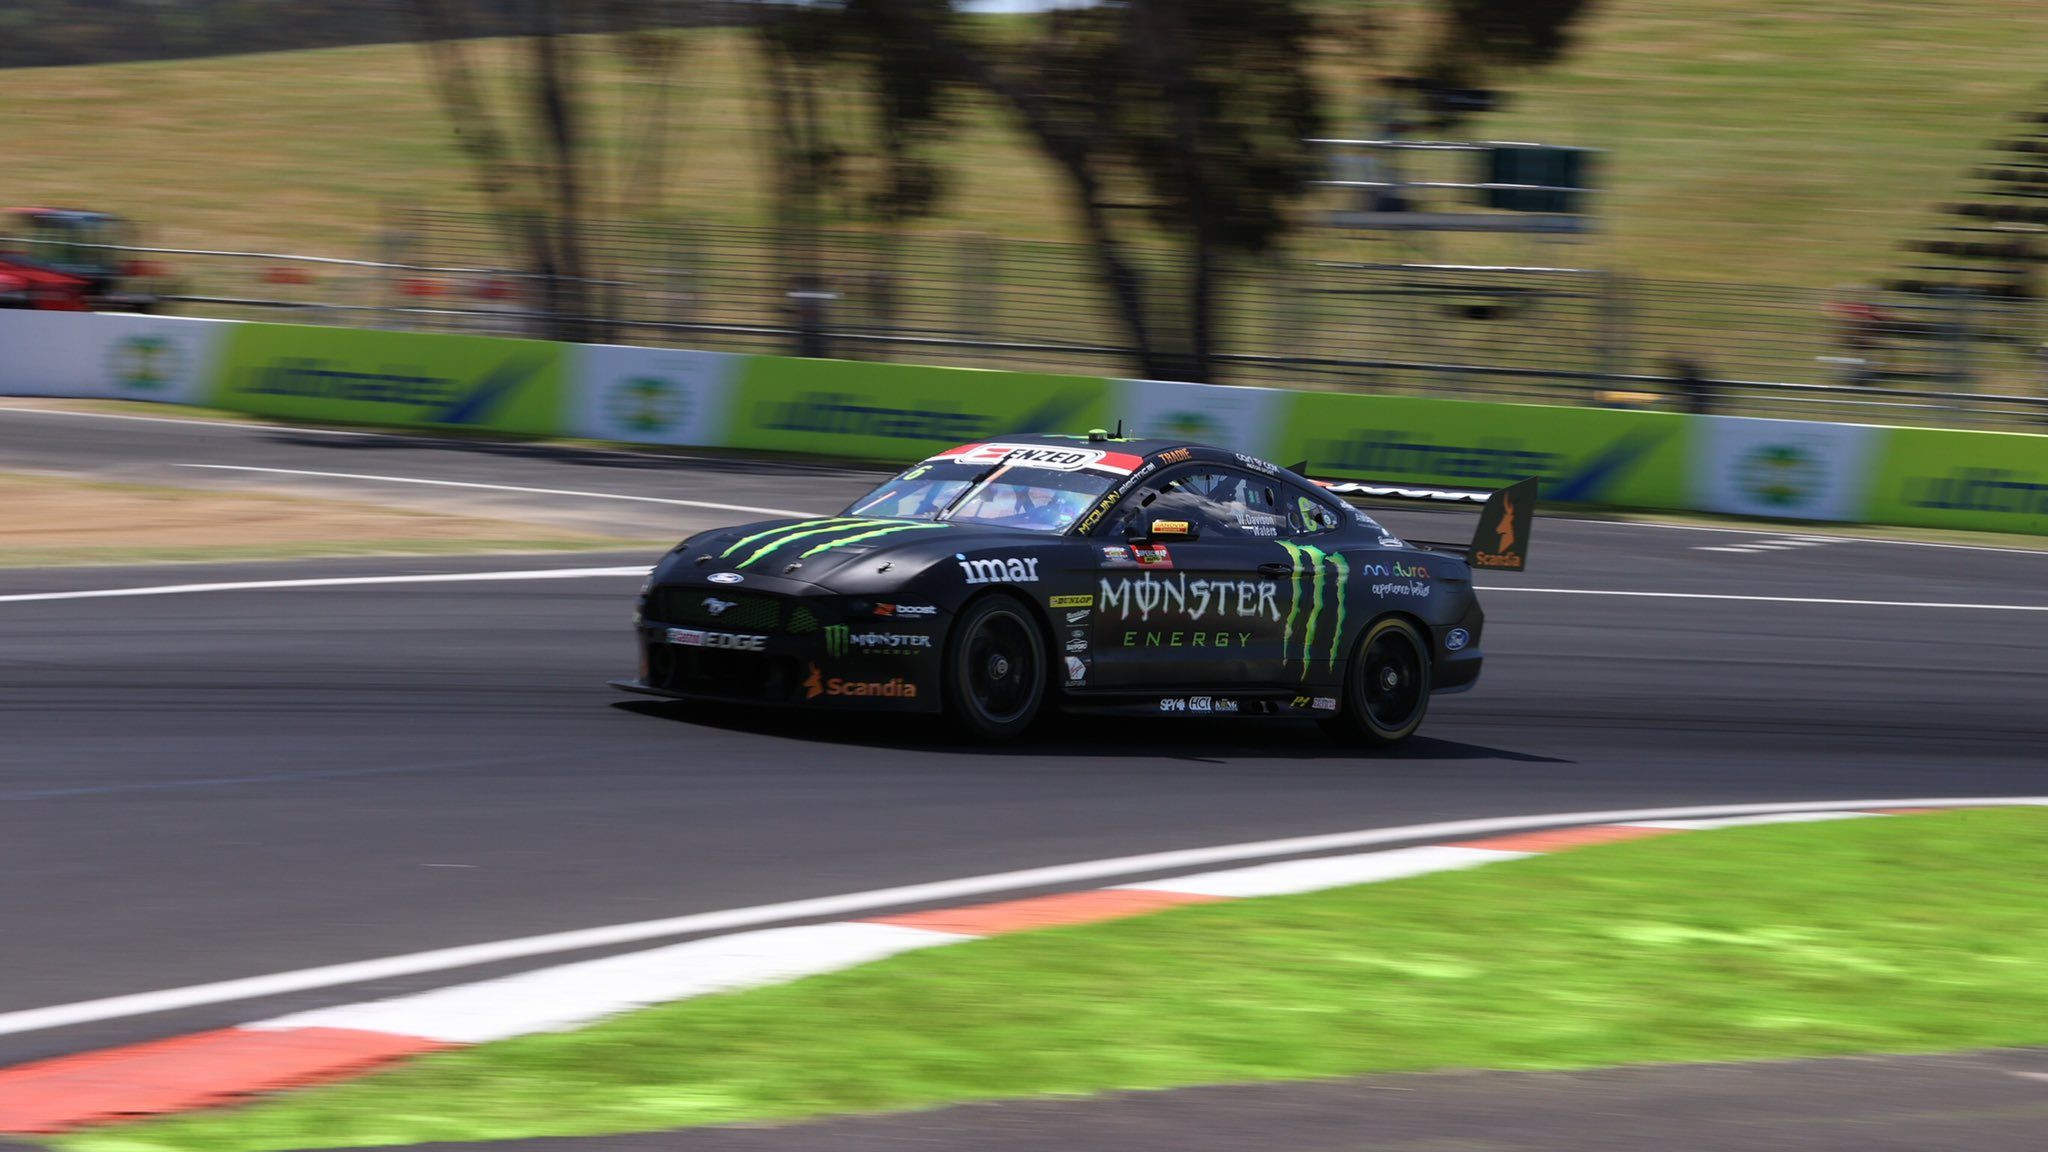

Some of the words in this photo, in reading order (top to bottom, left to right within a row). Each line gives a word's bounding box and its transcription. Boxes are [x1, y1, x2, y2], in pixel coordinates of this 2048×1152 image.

[1005, 449, 1086, 464] ENZED
[1157, 447, 1192, 465] TRADIE
[903, 464, 933, 481] 6
[1475, 551, 1522, 568] Scandia
[956, 552, 1040, 585] imar
[1100, 571, 1281, 622] MONSTER
[1372, 582, 1410, 599] experience
[1058, 596, 1092, 604] DUNLOP
[895, 604, 938, 615] boost
[705, 631, 770, 652] EDGE
[849, 631, 932, 648] MONSTER
[1124, 631, 1252, 648] ENERGY
[826, 677, 917, 698] Scandia
